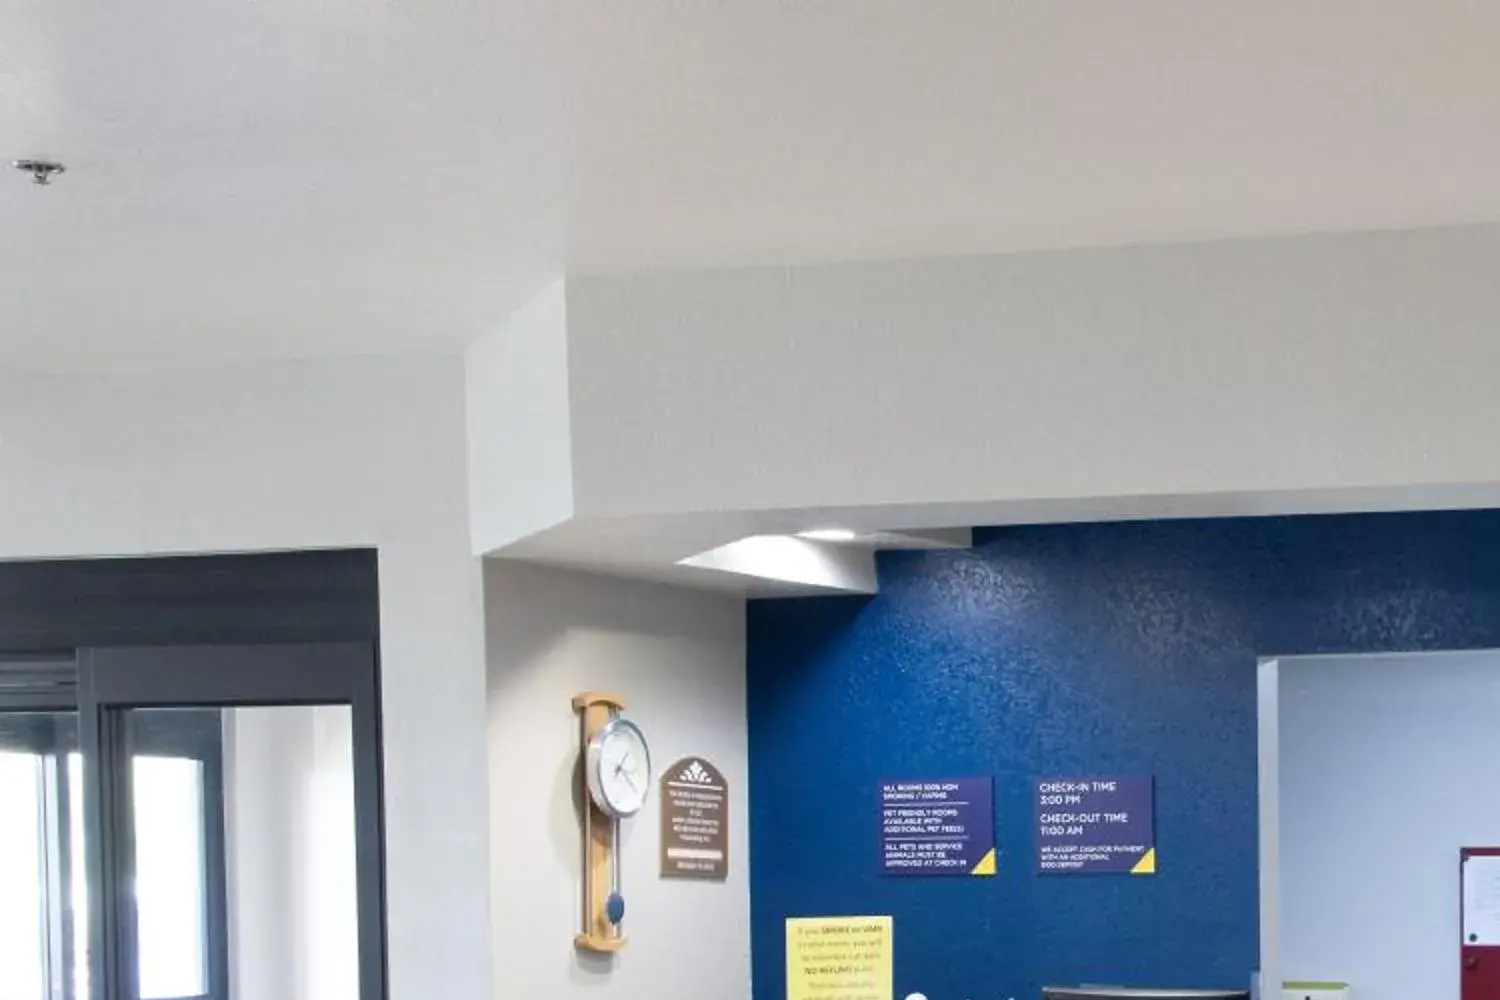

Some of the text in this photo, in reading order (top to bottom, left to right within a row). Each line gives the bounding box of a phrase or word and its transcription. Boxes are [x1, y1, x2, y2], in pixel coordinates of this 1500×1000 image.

[1039, 781, 1117, 792] CHECK-IN TIME
[1040, 795, 1081, 805] 3:00 PM
[884, 808, 958, 817] PET FRIENDLY ROOMS
[1040, 812, 1128, 823] CHECK-OUT TIME
[1041, 826, 1083, 835] 11:00 AM
[934, 842, 963, 850] SERVICE
[1070, 853, 1109, 861] ADDITIONAL
[885, 859, 922, 867] APPROVED
[924, 859, 933, 867] AT
[934, 859, 958, 867] CHECK
